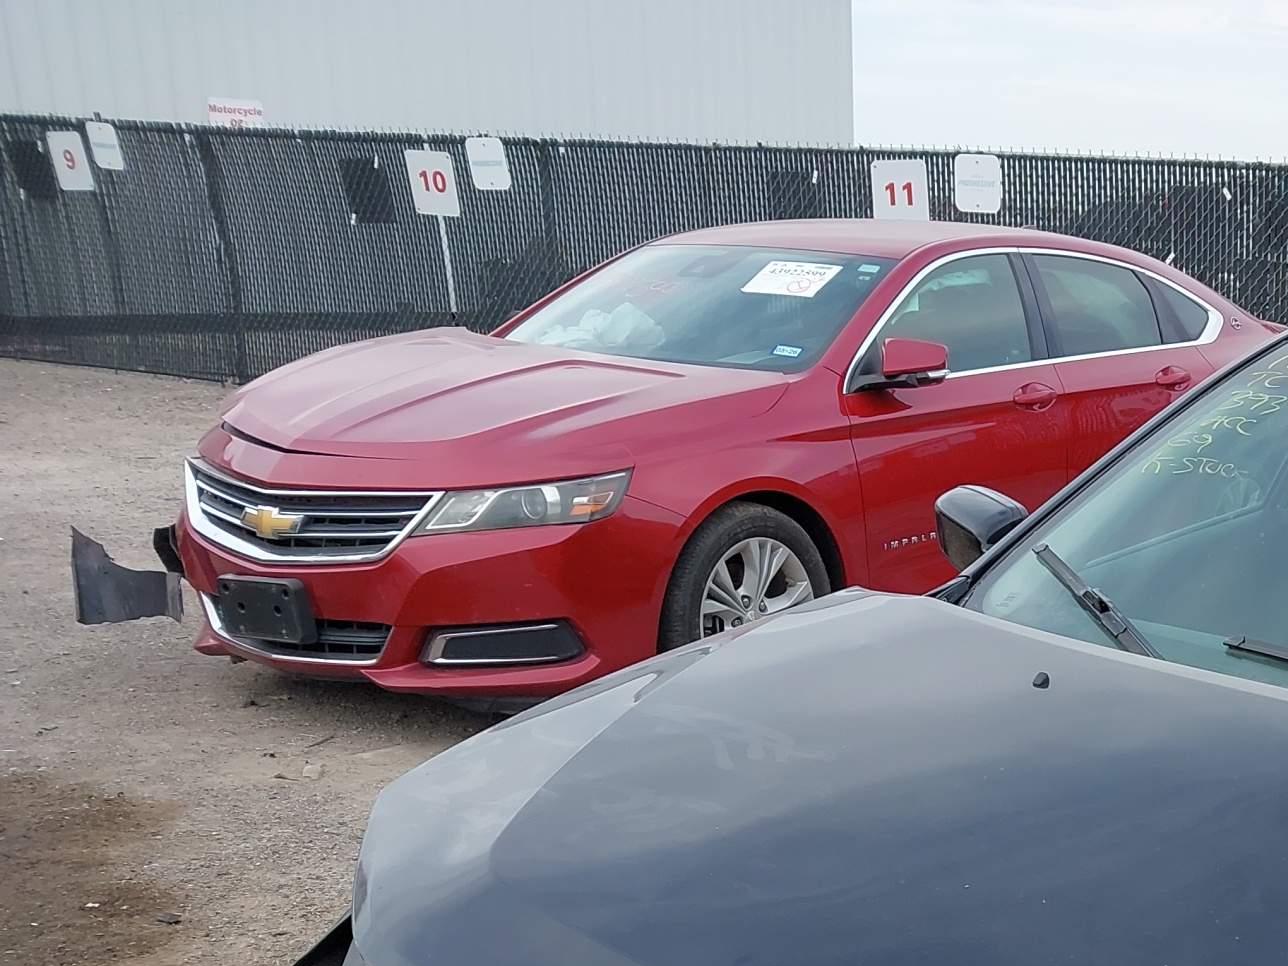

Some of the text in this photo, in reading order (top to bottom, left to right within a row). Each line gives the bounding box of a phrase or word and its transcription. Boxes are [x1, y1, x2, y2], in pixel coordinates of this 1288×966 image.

[208, 104, 263, 116] Motorcycle
[63, 149, 76, 170] 9
[419, 170, 447, 193] 10
[885, 182, 913, 206] 11
[884, 532, 937, 551] IMPALA
